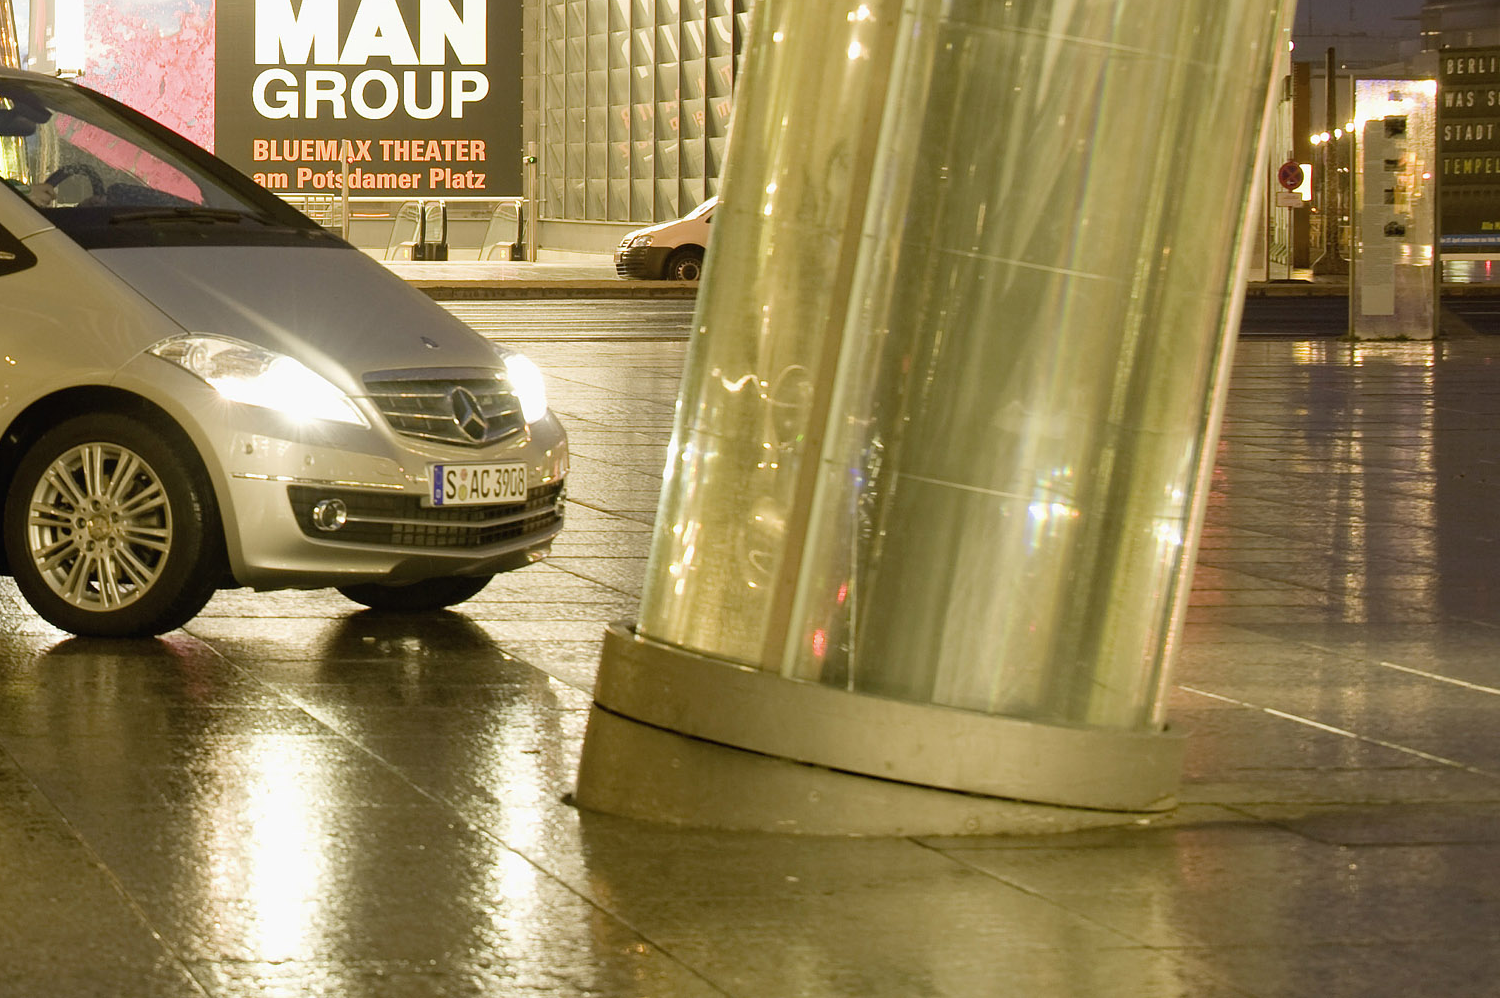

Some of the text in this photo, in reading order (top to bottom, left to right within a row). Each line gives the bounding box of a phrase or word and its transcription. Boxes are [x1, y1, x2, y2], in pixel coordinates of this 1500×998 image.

[1446, 58, 1500, 75] BERLI
[252, 67, 490, 120] GROUP
[1445, 91, 1475, 108] WAS
[1444, 124, 1494, 141] STADT
[253, 139, 487, 162] BLUEMAX THEATER
[253, 167, 487, 190] am Potsdamer Platz
[445, 467, 525, 500] S AC 3908
